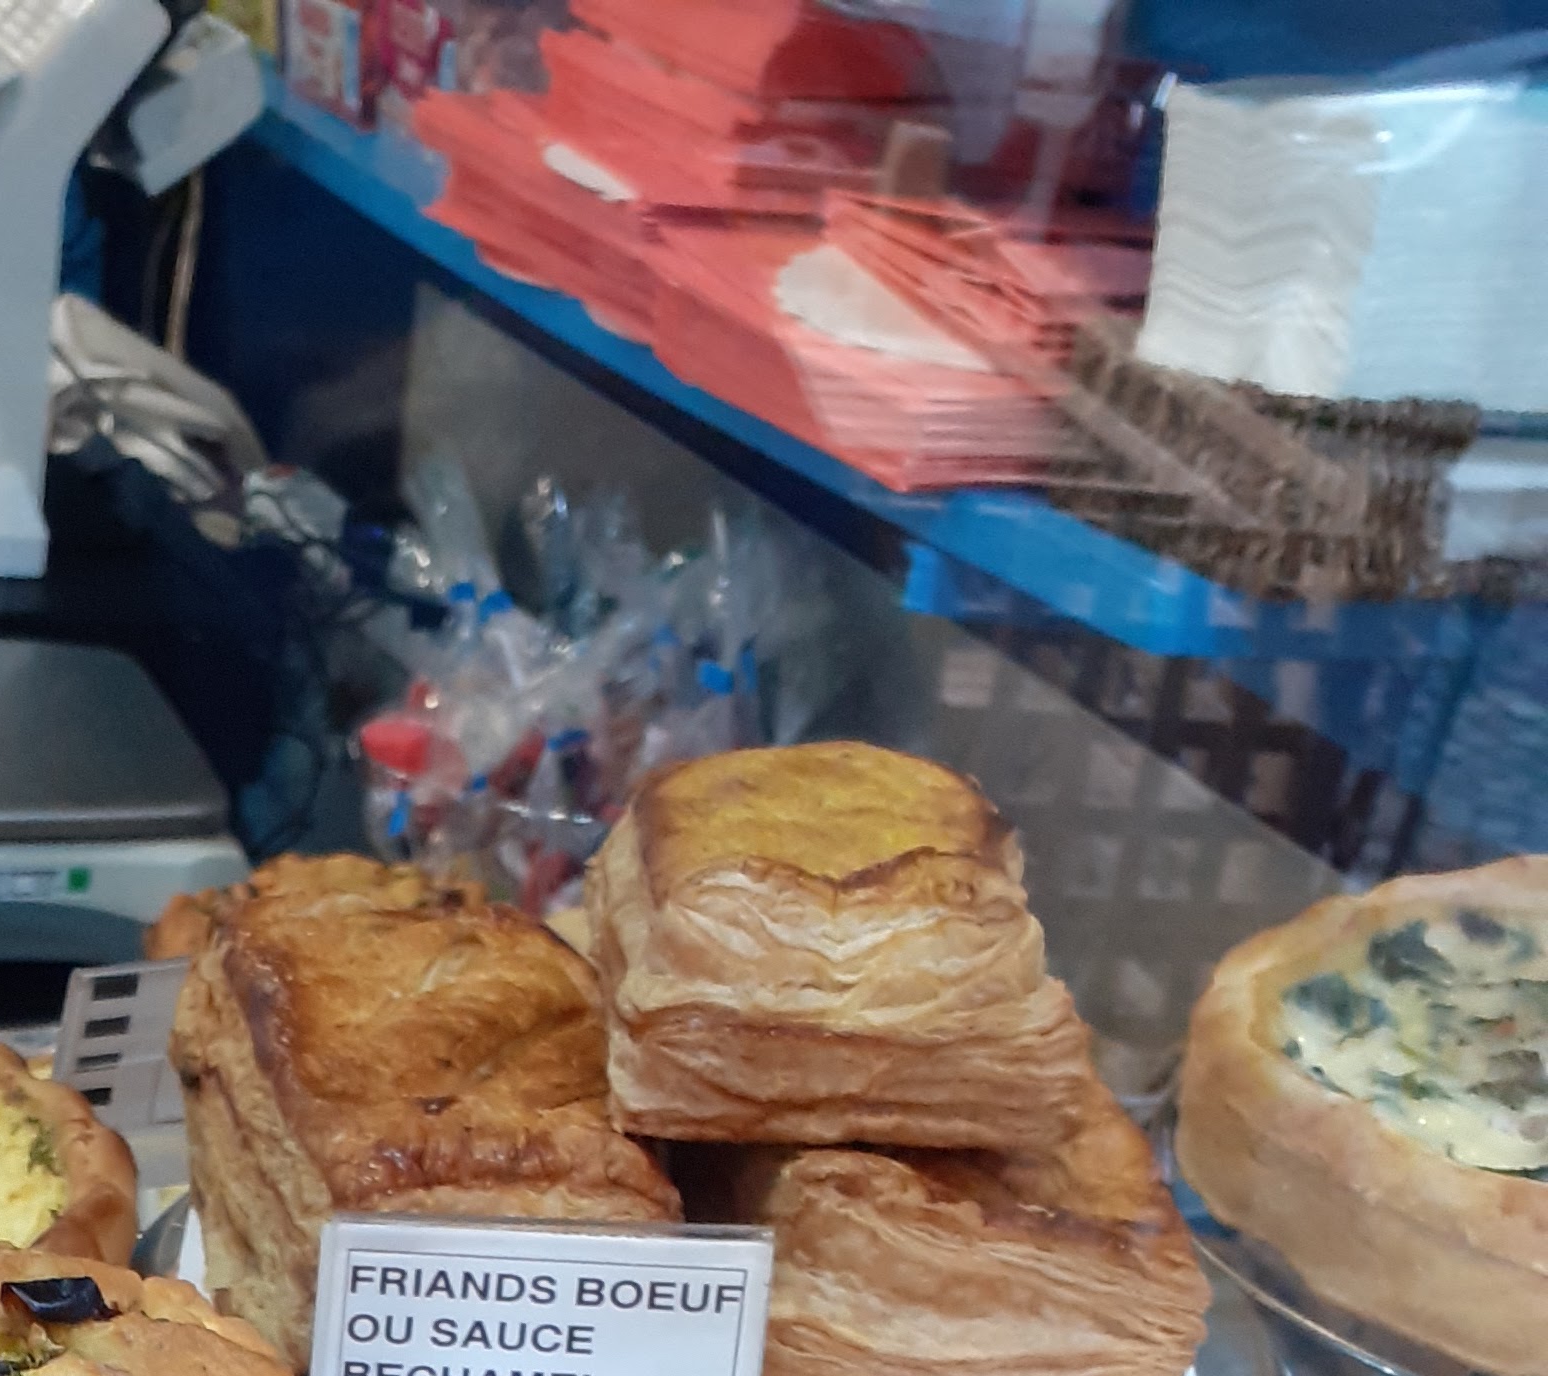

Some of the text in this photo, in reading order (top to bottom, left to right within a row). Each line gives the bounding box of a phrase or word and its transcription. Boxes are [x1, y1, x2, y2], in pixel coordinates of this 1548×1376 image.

[349, 1265, 745, 1314] FRIANDS BOEUF
[347, 1313, 596, 1355] OU SAUCE
